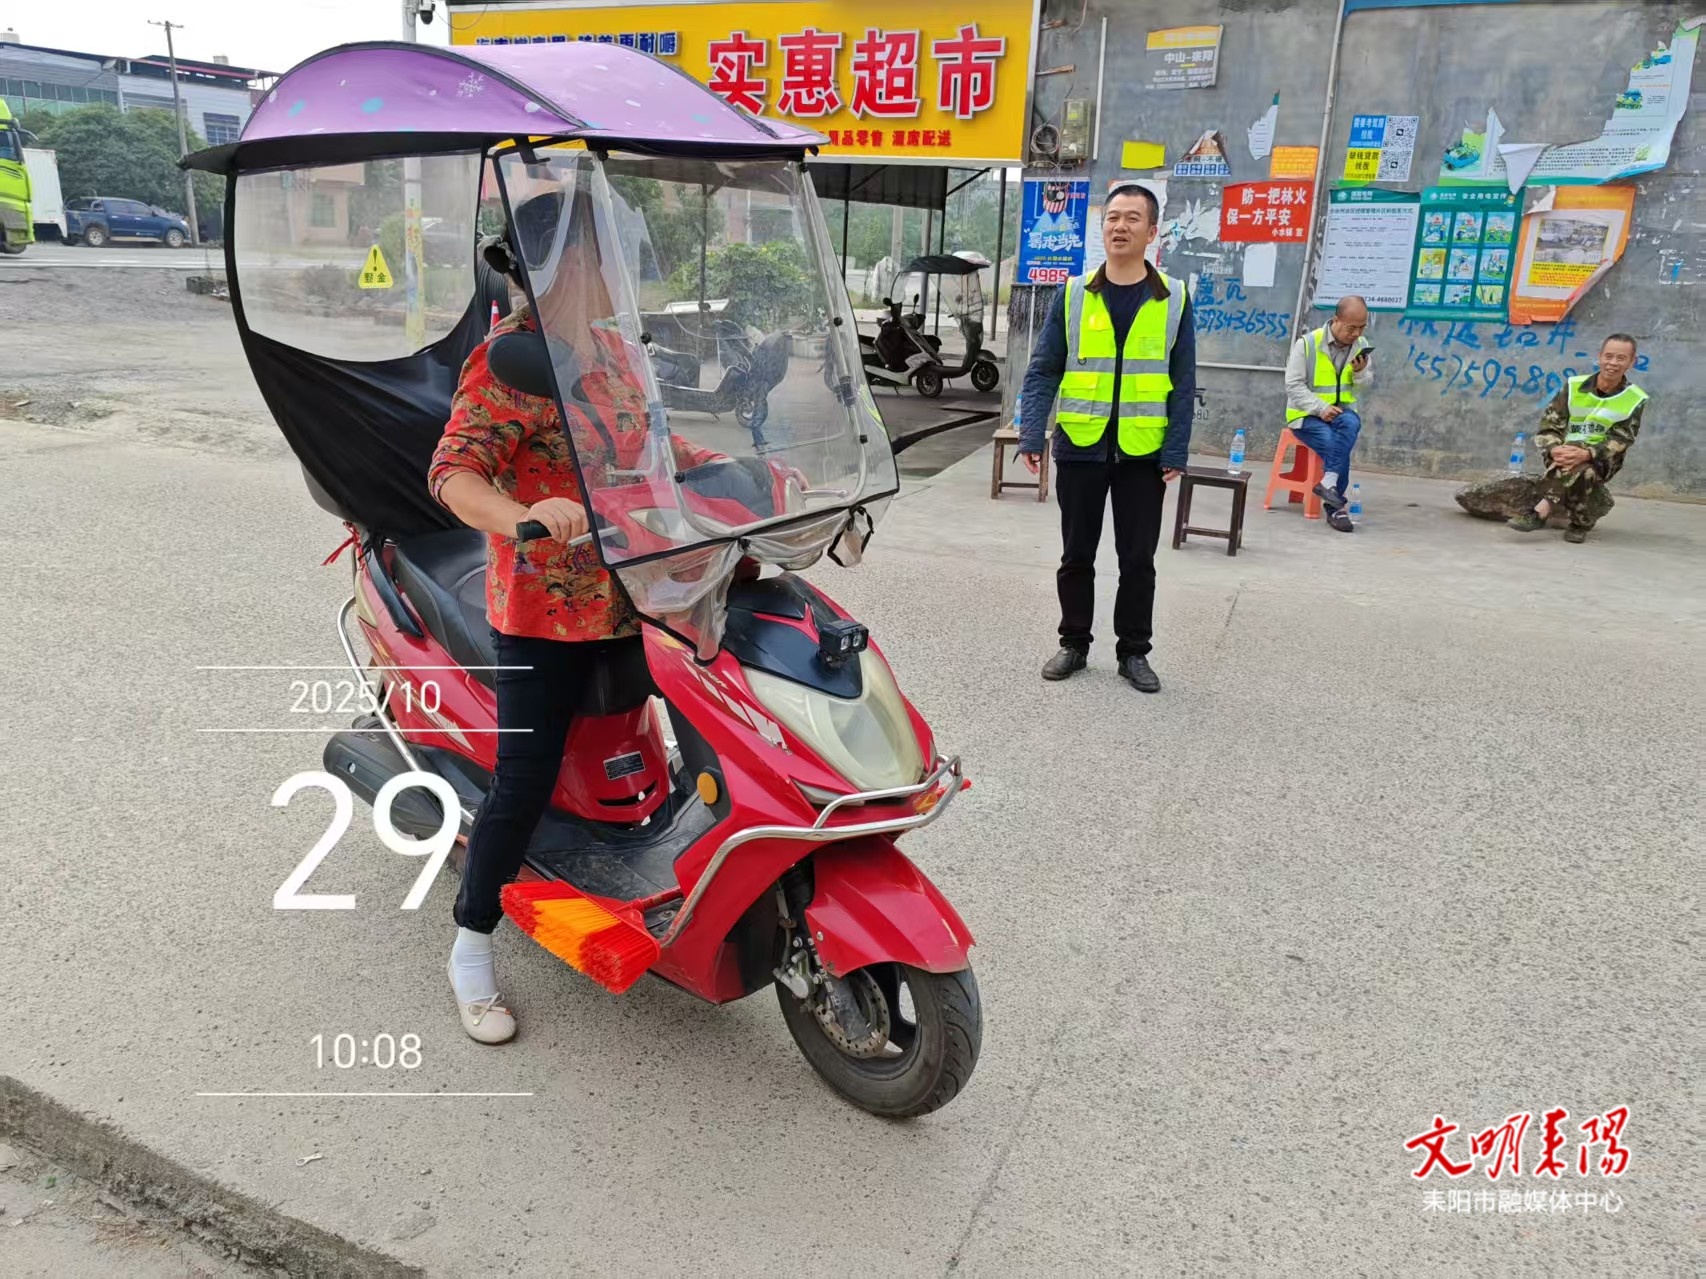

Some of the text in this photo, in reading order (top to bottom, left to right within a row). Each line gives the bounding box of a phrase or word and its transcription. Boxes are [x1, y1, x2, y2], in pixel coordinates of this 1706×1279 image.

[708, 23, 1006, 119] 实惠超市
[819, 130, 883, 146] 用品零售
[1241, 187, 1307, 205] 防一把林火
[1226, 208, 1292, 226] 保一方平安
[1028, 266, 1069, 284] 4985
